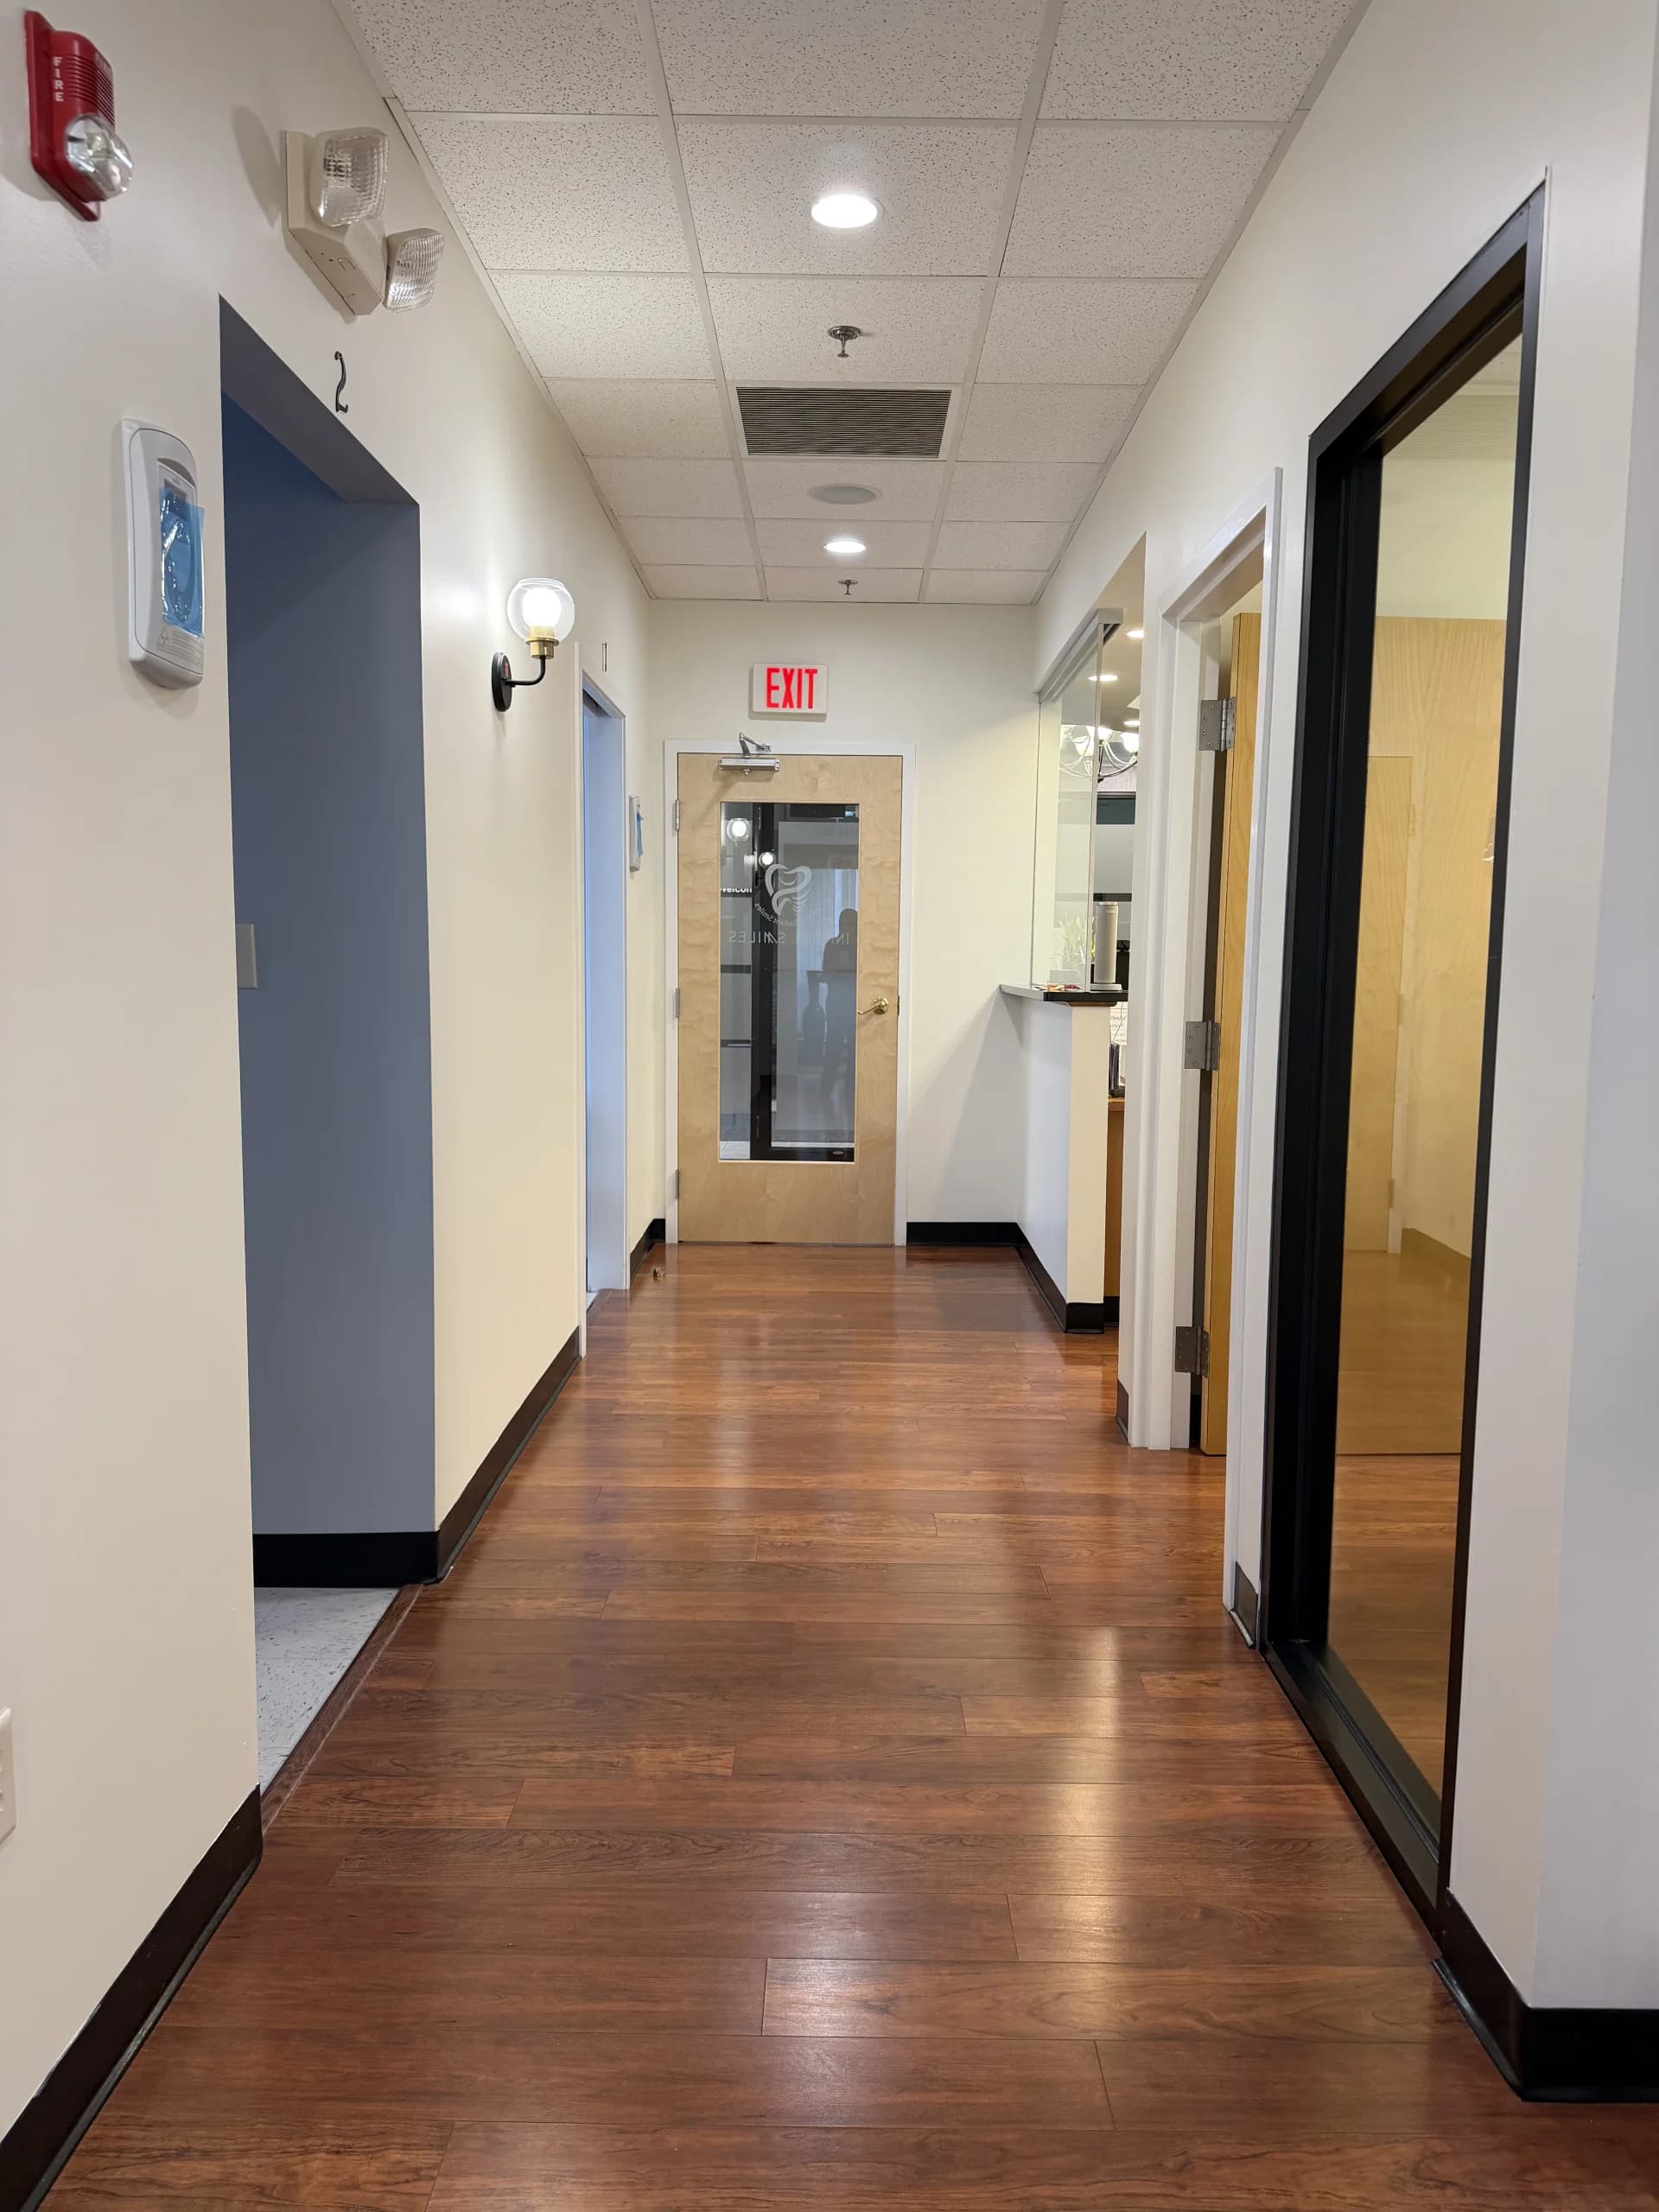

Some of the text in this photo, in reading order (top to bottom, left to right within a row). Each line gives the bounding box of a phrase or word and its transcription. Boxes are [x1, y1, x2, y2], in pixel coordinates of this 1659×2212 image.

[53, 56, 64, 102] FIRE
[334, 351, 348, 413] 2
[766, 667, 818, 709] EXIT
